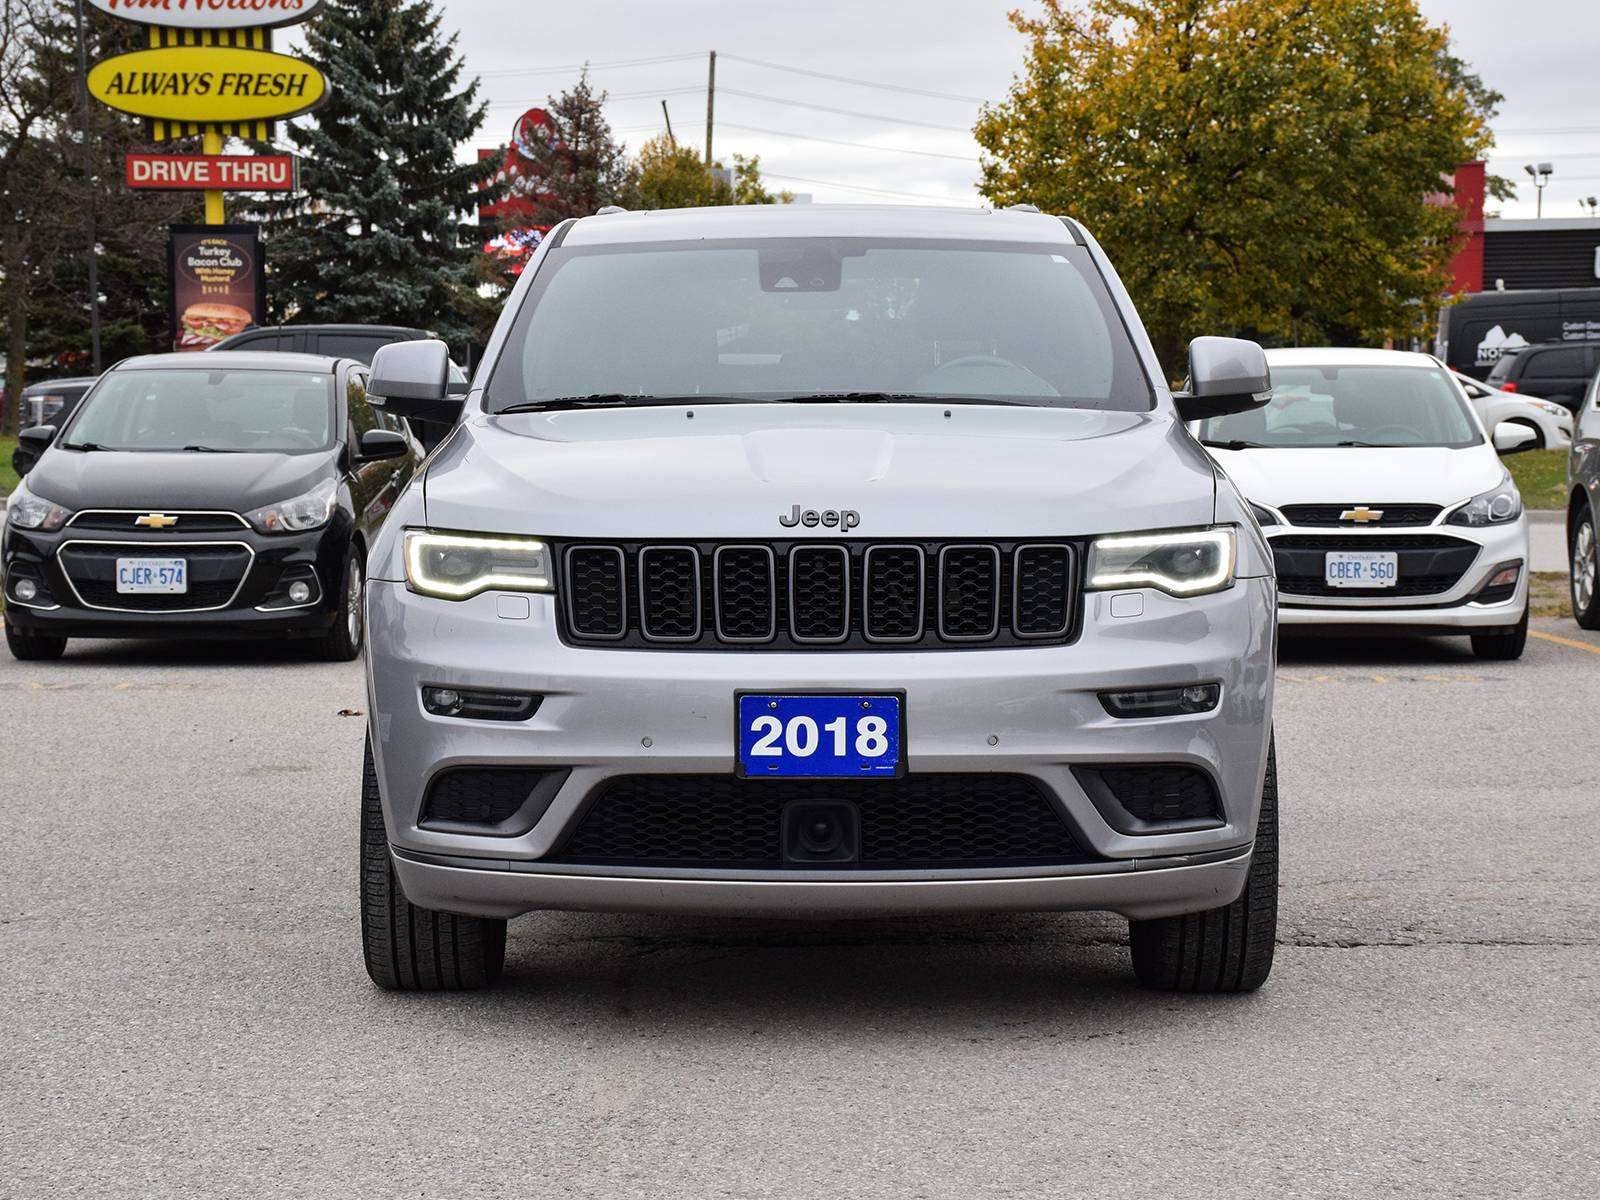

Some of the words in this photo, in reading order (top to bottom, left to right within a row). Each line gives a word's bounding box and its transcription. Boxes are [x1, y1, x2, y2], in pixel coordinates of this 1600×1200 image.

[105, 72, 213, 96] ALWAYS
[217, 73, 308, 97] FRESH
[132, 160, 210, 182] DRIVE
[216, 162, 287, 183] THRU
[188, 257, 218, 266] Bacon
[219, 257, 242, 266] Club
[198, 246, 231, 257] Turkey
[779, 504, 860, 532] Jeep
[120, 568, 152, 584] CJER
[159, 568, 183, 584] 574
[1329, 562, 1361, 579] CBER
[1370, 562, 1394, 579] 560
[750, 715, 889, 757] 2018
